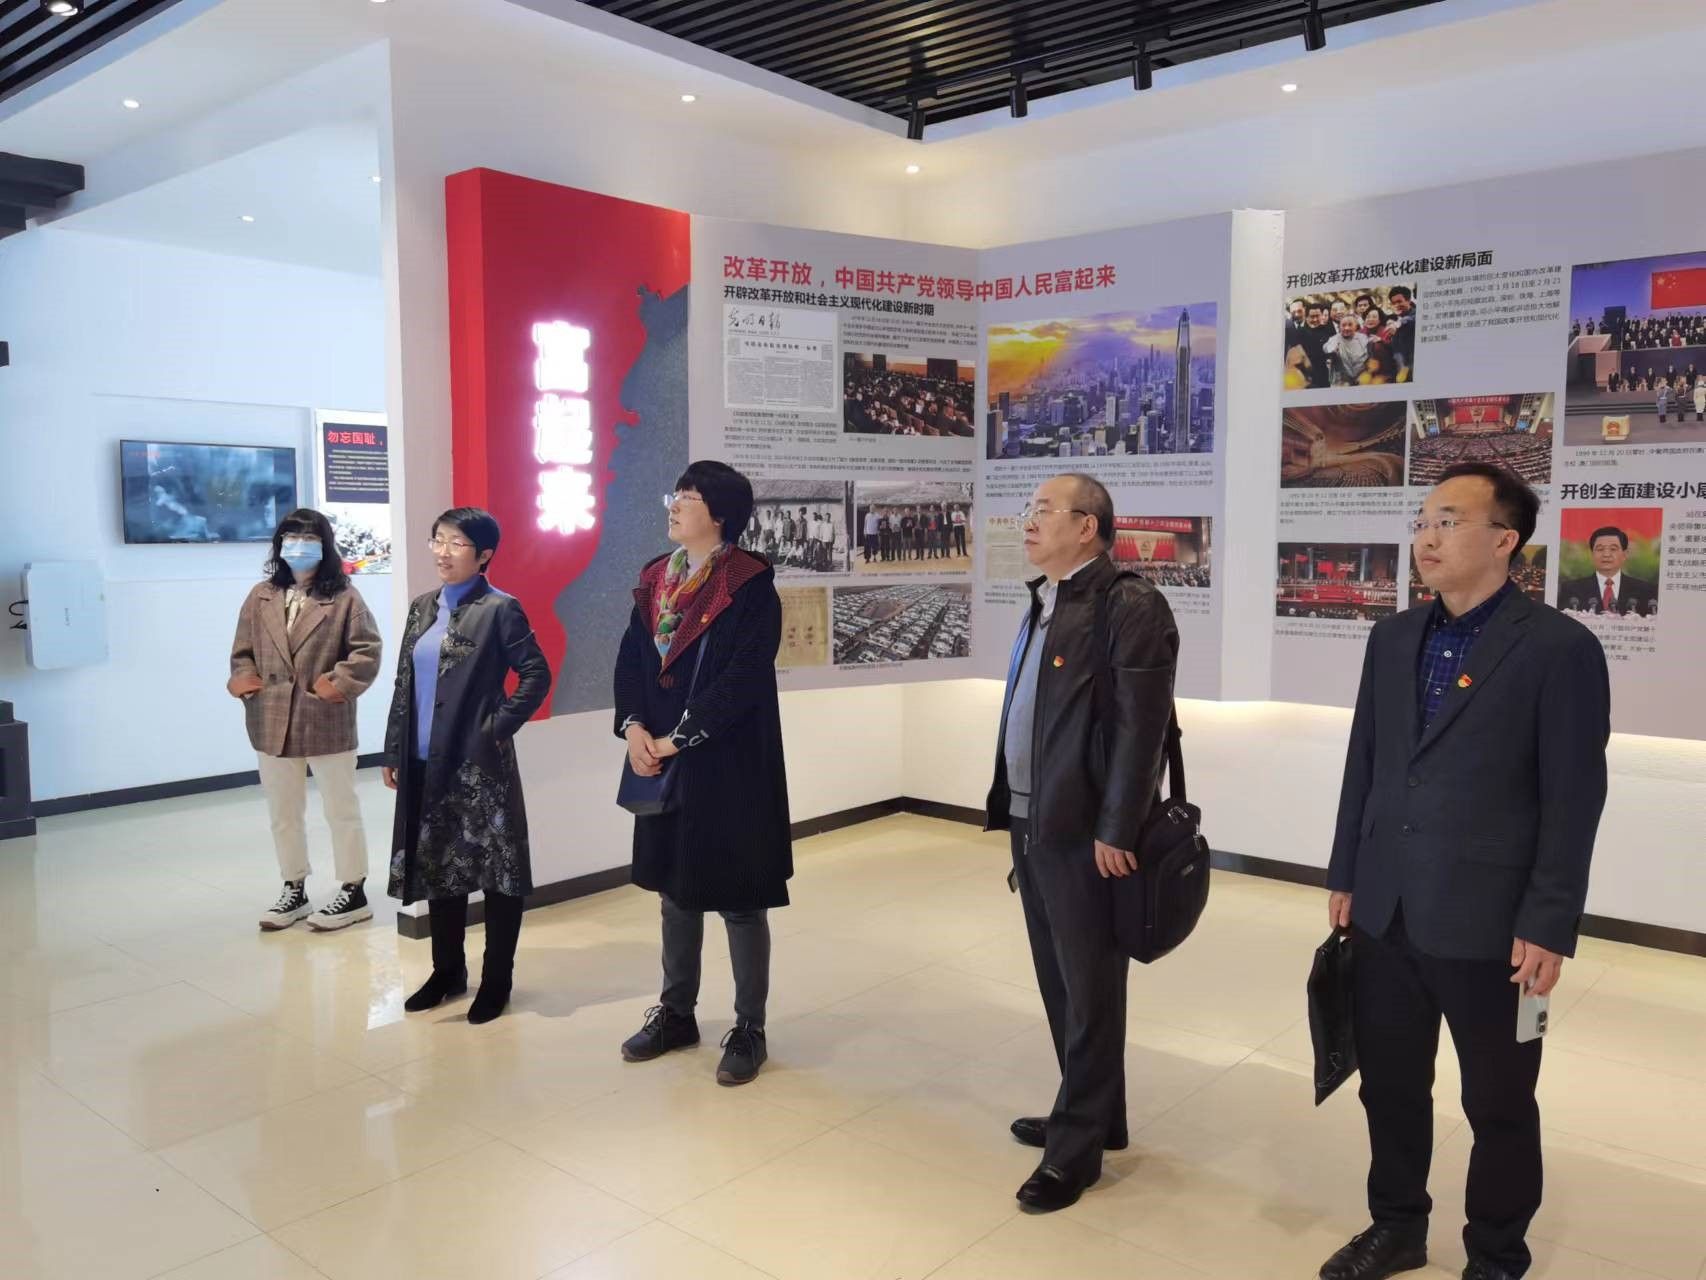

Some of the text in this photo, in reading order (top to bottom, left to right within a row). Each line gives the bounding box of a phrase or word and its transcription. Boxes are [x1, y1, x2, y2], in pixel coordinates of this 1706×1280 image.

[723, 255, 1117, 303] 改革开放，中国共产党领导中国人民富起来
[1287, 250, 1493, 288] 开创改革开放现代化建设新局面
[723, 285, 935, 316] 开辟改革开放和社会主义现代化建设新时期
